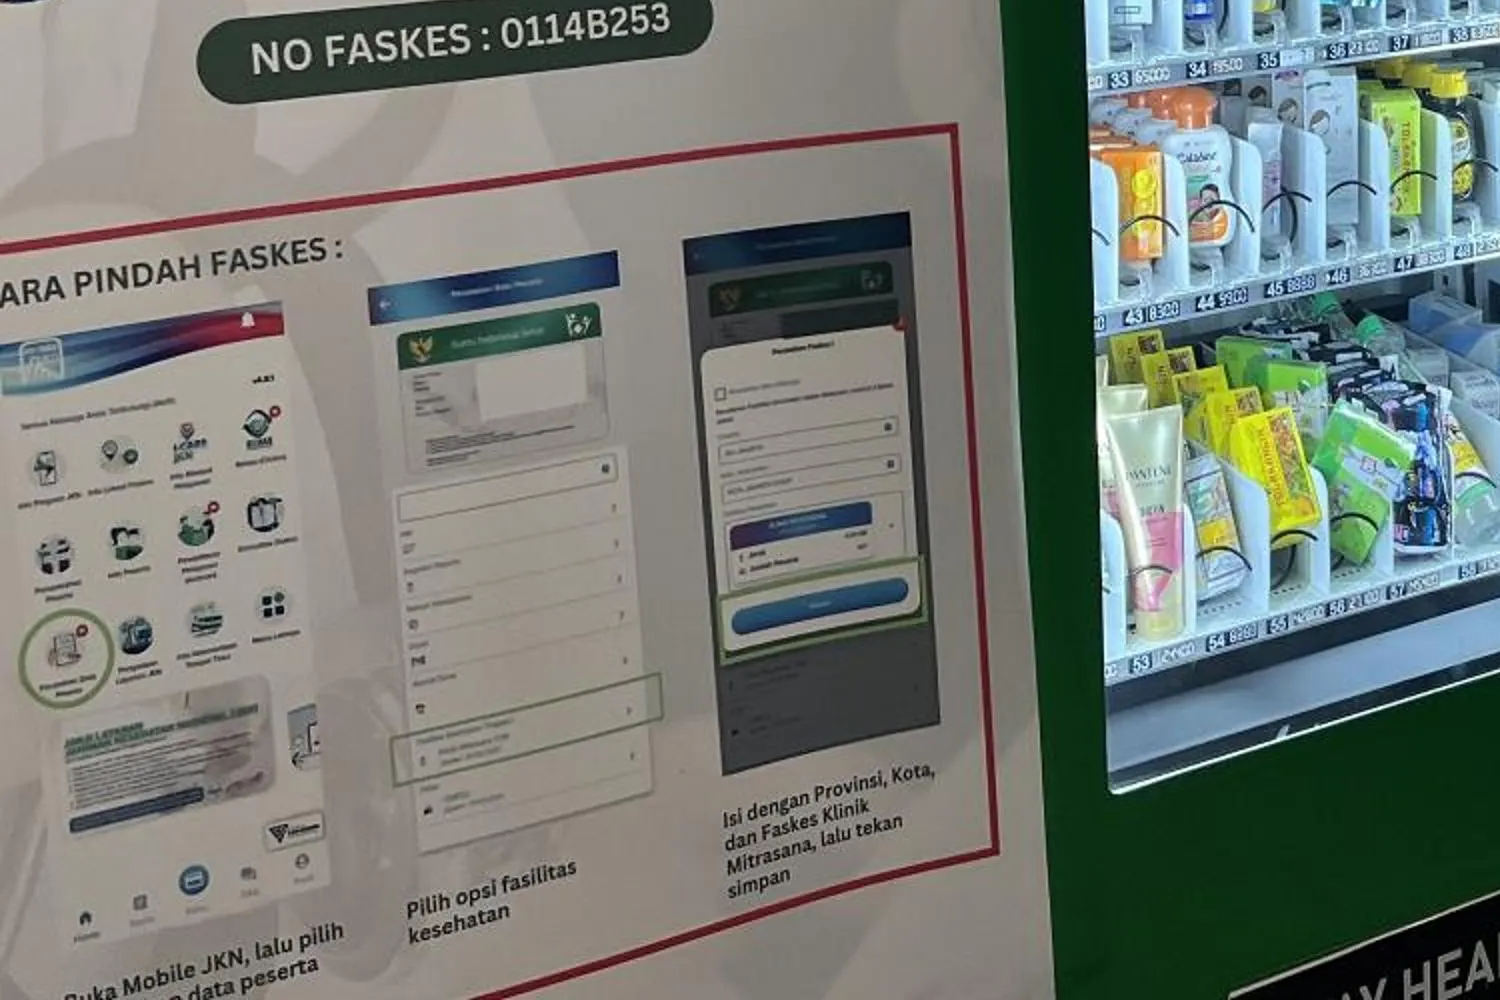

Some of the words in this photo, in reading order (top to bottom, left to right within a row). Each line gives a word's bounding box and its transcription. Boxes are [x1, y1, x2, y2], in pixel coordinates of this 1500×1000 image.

[250, 36, 312, 77] NO
[325, 24, 472, 69] FASKES
[500, 2, 671, 50] 0114B253
[1393, 35, 1409, 49] 37
[1260, 53, 1277, 68] 35
[1188, 63, 1207, 78] 34
[1110, 72, 1130, 89] 33
[74, 253, 201, 297] PINDAH
[211, 237, 327, 276] FASKES
[1396, 256, 1413, 269] 47
[1330, 269, 1348, 284] 46
[1267, 281, 1285, 296] 45
[1198, 296, 1217, 311] 44
[1125, 309, 1143, 325] 43
[1270, 617, 1288, 632] 55
[1208, 634, 1225, 650] 54
[1132, 656, 1150, 673] 53
[723, 811, 743, 829] Isi
[747, 791, 810, 820] dengan
[815, 770, 888, 803] Provinsi,
[892, 762, 936, 784] Kota,
[725, 831, 757, 851] dan
[762, 815, 818, 841] Faskes
[823, 799, 869, 825] Klinik
[727, 839, 817, 876] Mitrasana,
[821, 825, 851, 846] lalu
[855, 814, 903, 838] tekan
[406, 895, 450, 920] Pilih
[456, 880, 497, 907] opsi
[501, 860, 577, 894] fasilitas
[728, 868, 791, 899] simpan
[409, 904, 510, 944] kesehatan
[123, 961, 195, 996] Mobile
[200, 948, 250, 975] JKN,
[255, 937, 293, 961] lalu
[299, 922, 345, 952] pilih
[240, 957, 319, 990] peserta
